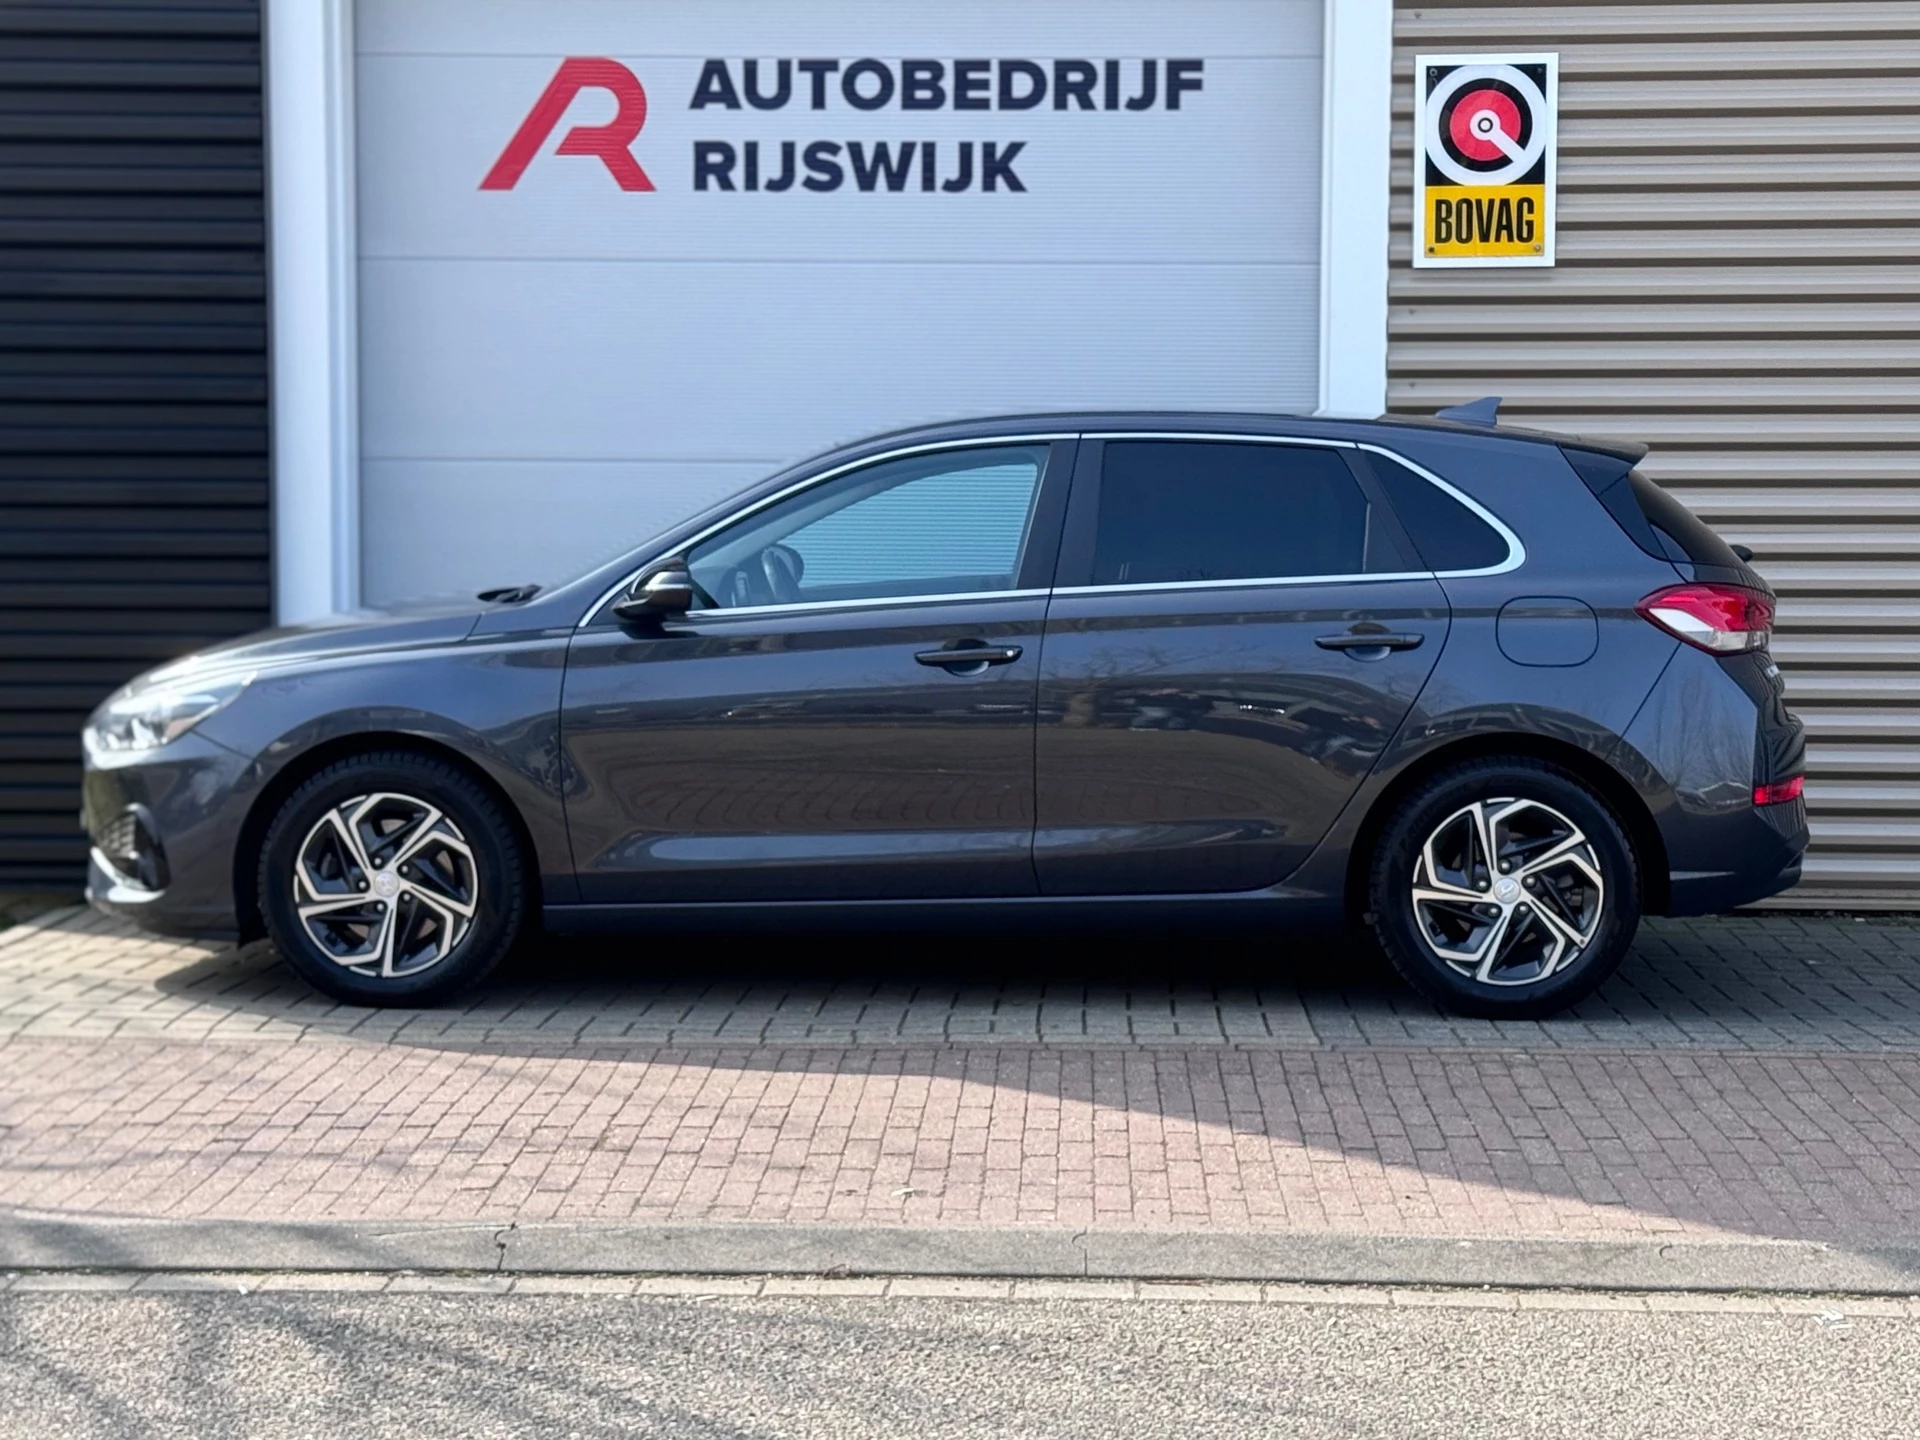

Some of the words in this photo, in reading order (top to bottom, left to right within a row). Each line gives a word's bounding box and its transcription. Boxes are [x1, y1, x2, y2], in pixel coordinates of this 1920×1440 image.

[689, 58, 1204, 111] AUTOBEDRIJF
[693, 141, 1027, 193] RIJSWIJK
[1434, 197, 1535, 244] BOVAG
